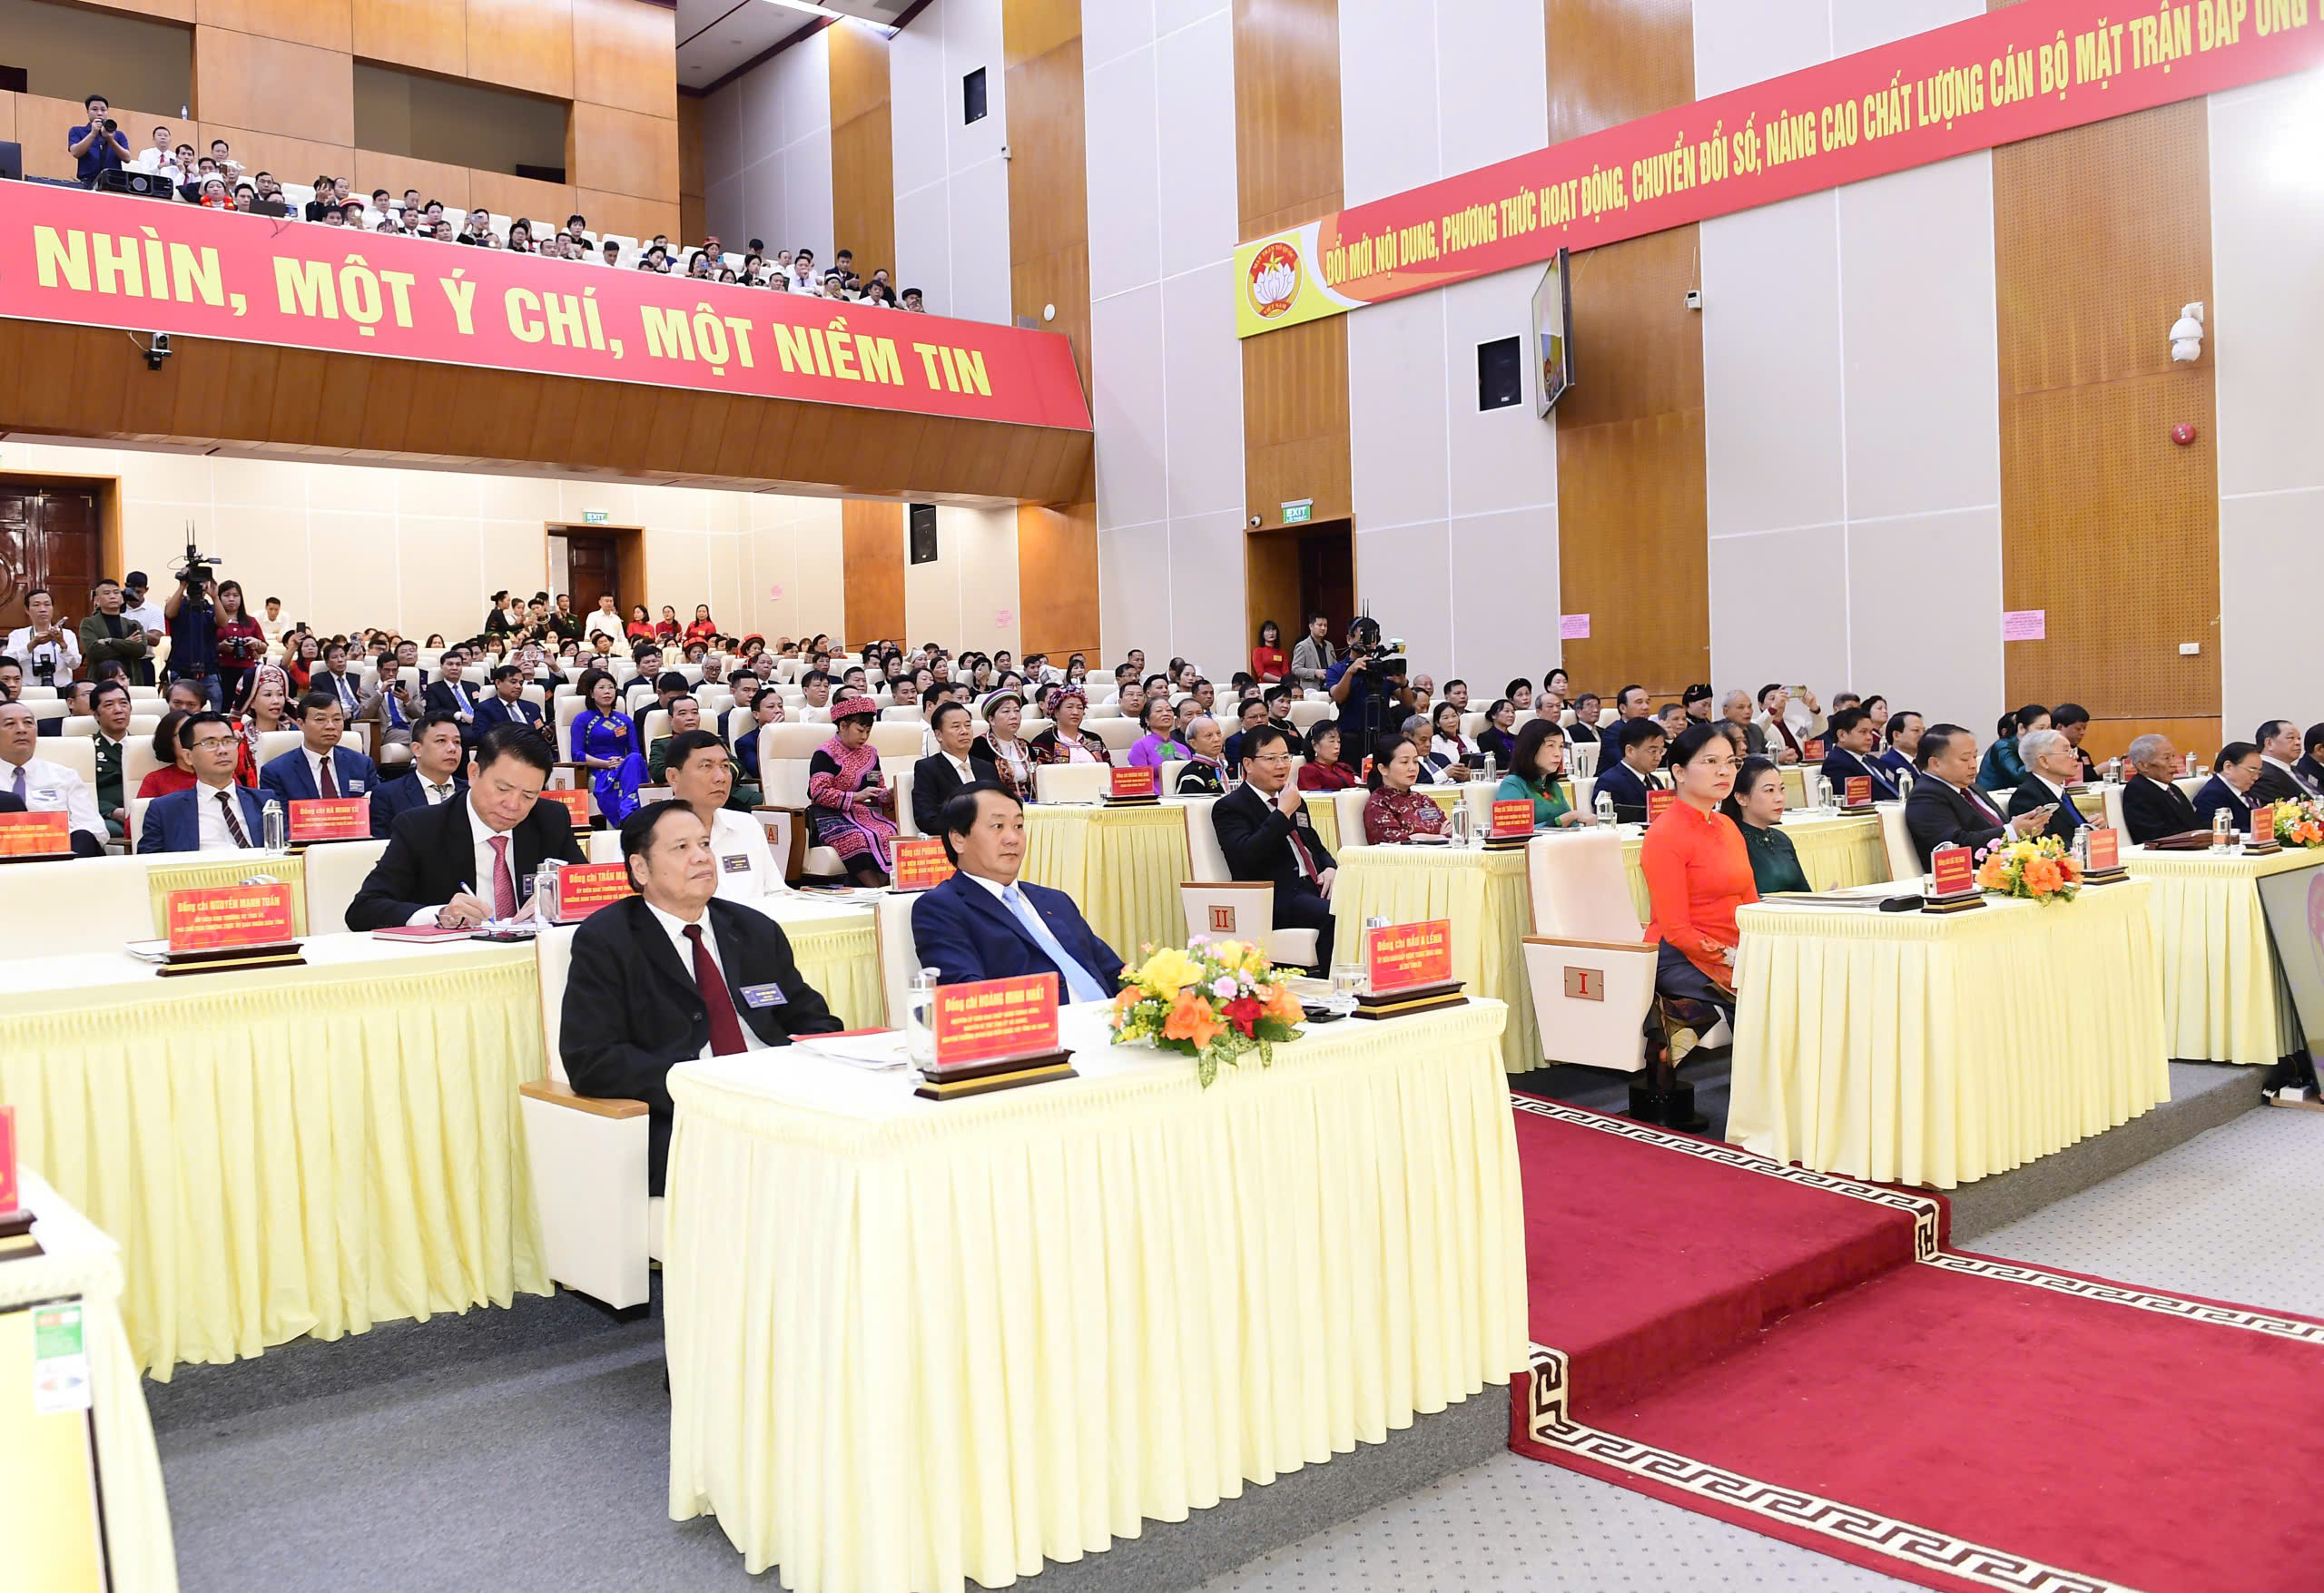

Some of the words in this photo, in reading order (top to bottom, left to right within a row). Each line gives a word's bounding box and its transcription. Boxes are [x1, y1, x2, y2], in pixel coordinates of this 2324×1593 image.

[1325, 233, 1346, 288] ĐỔI
[1348, 229, 1373, 280] MỚI
[1375, 227, 1398, 278] NỘI
[1400, 221, 1440, 269] DUNG,
[1442, 202, 1498, 255] PHƯƠNG
[1500, 185, 1537, 238] THỨC
[1540, 179, 1578, 234] HOẠT
[1581, 164, 1629, 223] ĐỘNG,
[1631, 130, 1696, 203] CHUYỂN
[1699, 119, 1728, 185] ĐỔI
[1732, 111, 1762, 175] SỐ;
[1766, 109, 1817, 167] NÂNG
[1821, 99, 1858, 152] CAO
[1863, 69, 1912, 143] CHẤT
[1916, 64, 1984, 131] LƯỢNG
[1989, 44, 2034, 107] CÁN
[2039, 29, 2070, 102] BỘ
[2075, 16, 2123, 90] MẶT
[2130, 0, 2192, 74] TRẬN
[33, 225, 247, 317] NHÌN,
[272, 254, 415, 337] MỘT
[439, 269, 476, 335] Ý
[504, 272, 624, 359] CHÍ,
[640, 302, 753, 377] MỘT
[773, 315, 905, 386] NIỀM
[913, 343, 992, 397] TIN
[1286, 506, 1307, 517] EXIT
[767, 827, 775, 841] A
[1215, 910, 1229, 928] II
[1579, 973, 1588, 994] I
